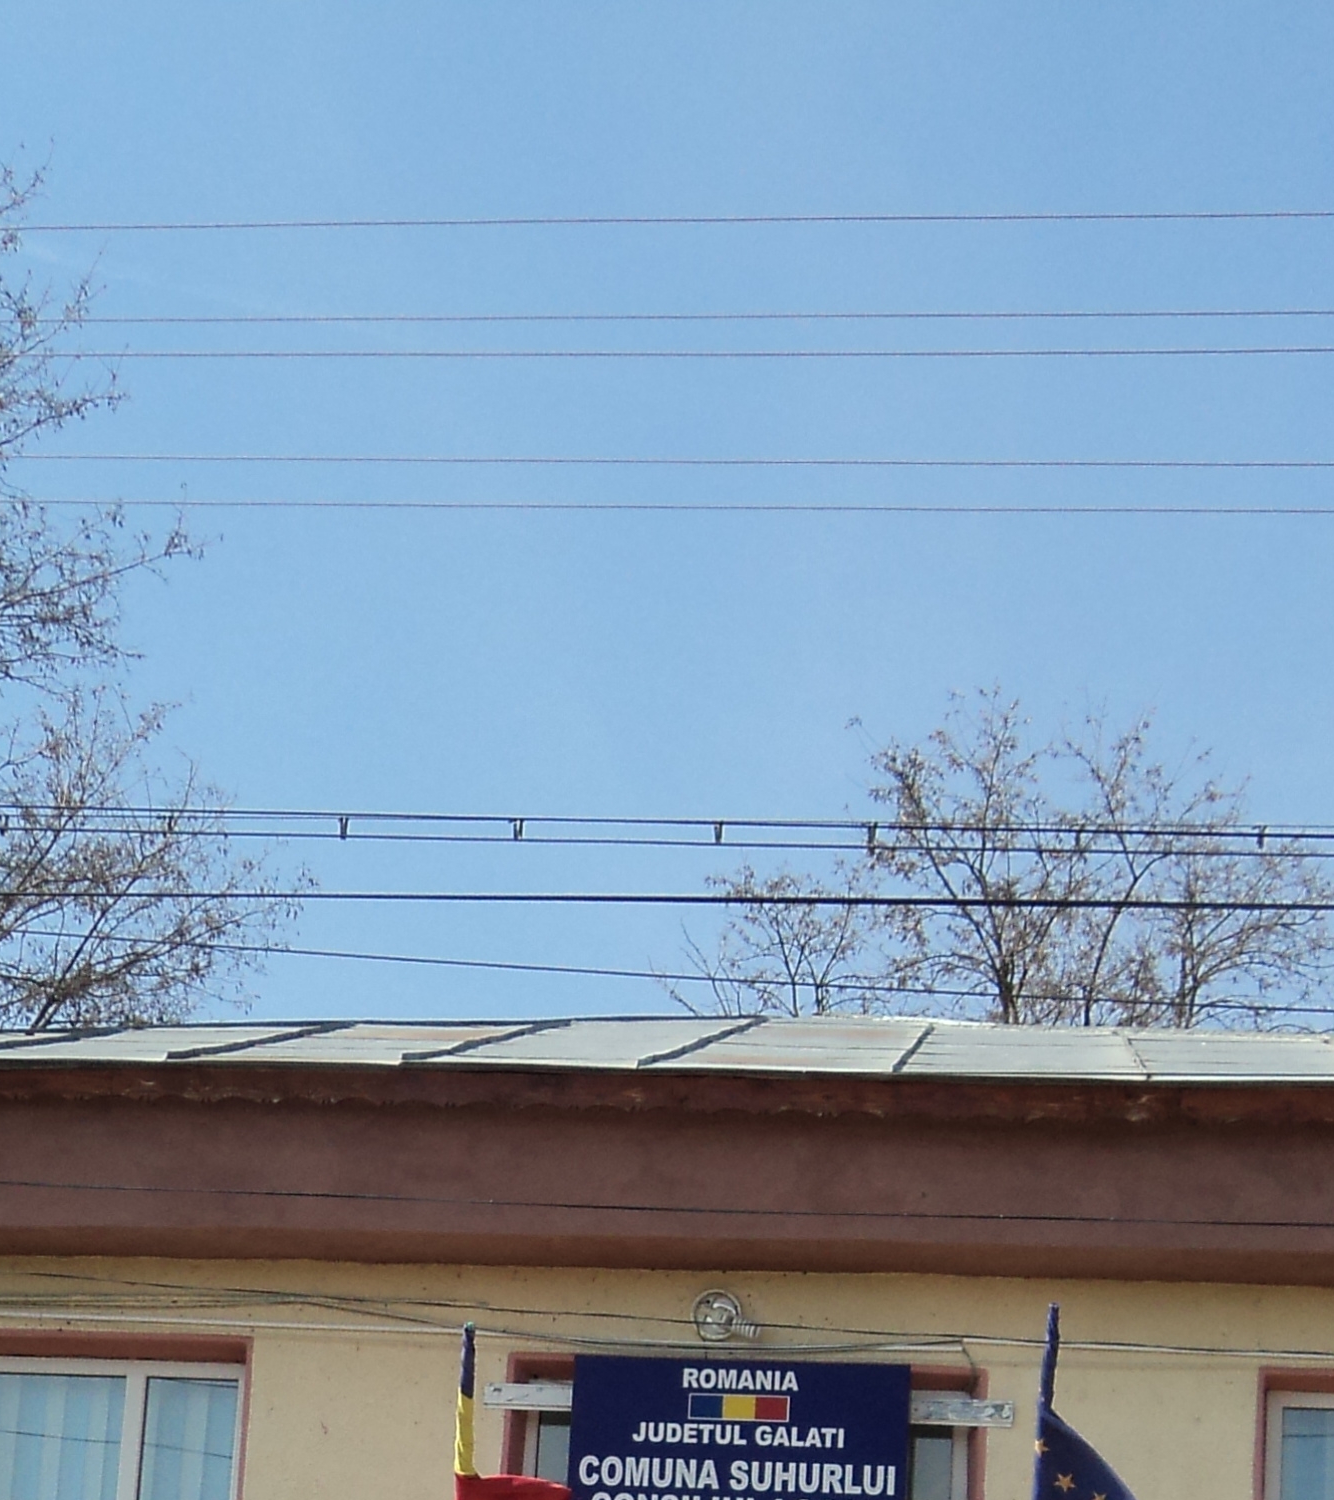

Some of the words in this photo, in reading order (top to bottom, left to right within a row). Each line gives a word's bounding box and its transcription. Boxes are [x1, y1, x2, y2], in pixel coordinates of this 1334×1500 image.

[682, 1367, 799, 1392] ROMANIA
[632, 1421, 748, 1446] JUDETUL
[754, 1425, 845, 1448] GALATI
[578, 1455, 720, 1490] COMUNA
[729, 1460, 896, 1496] SUHURLUI
